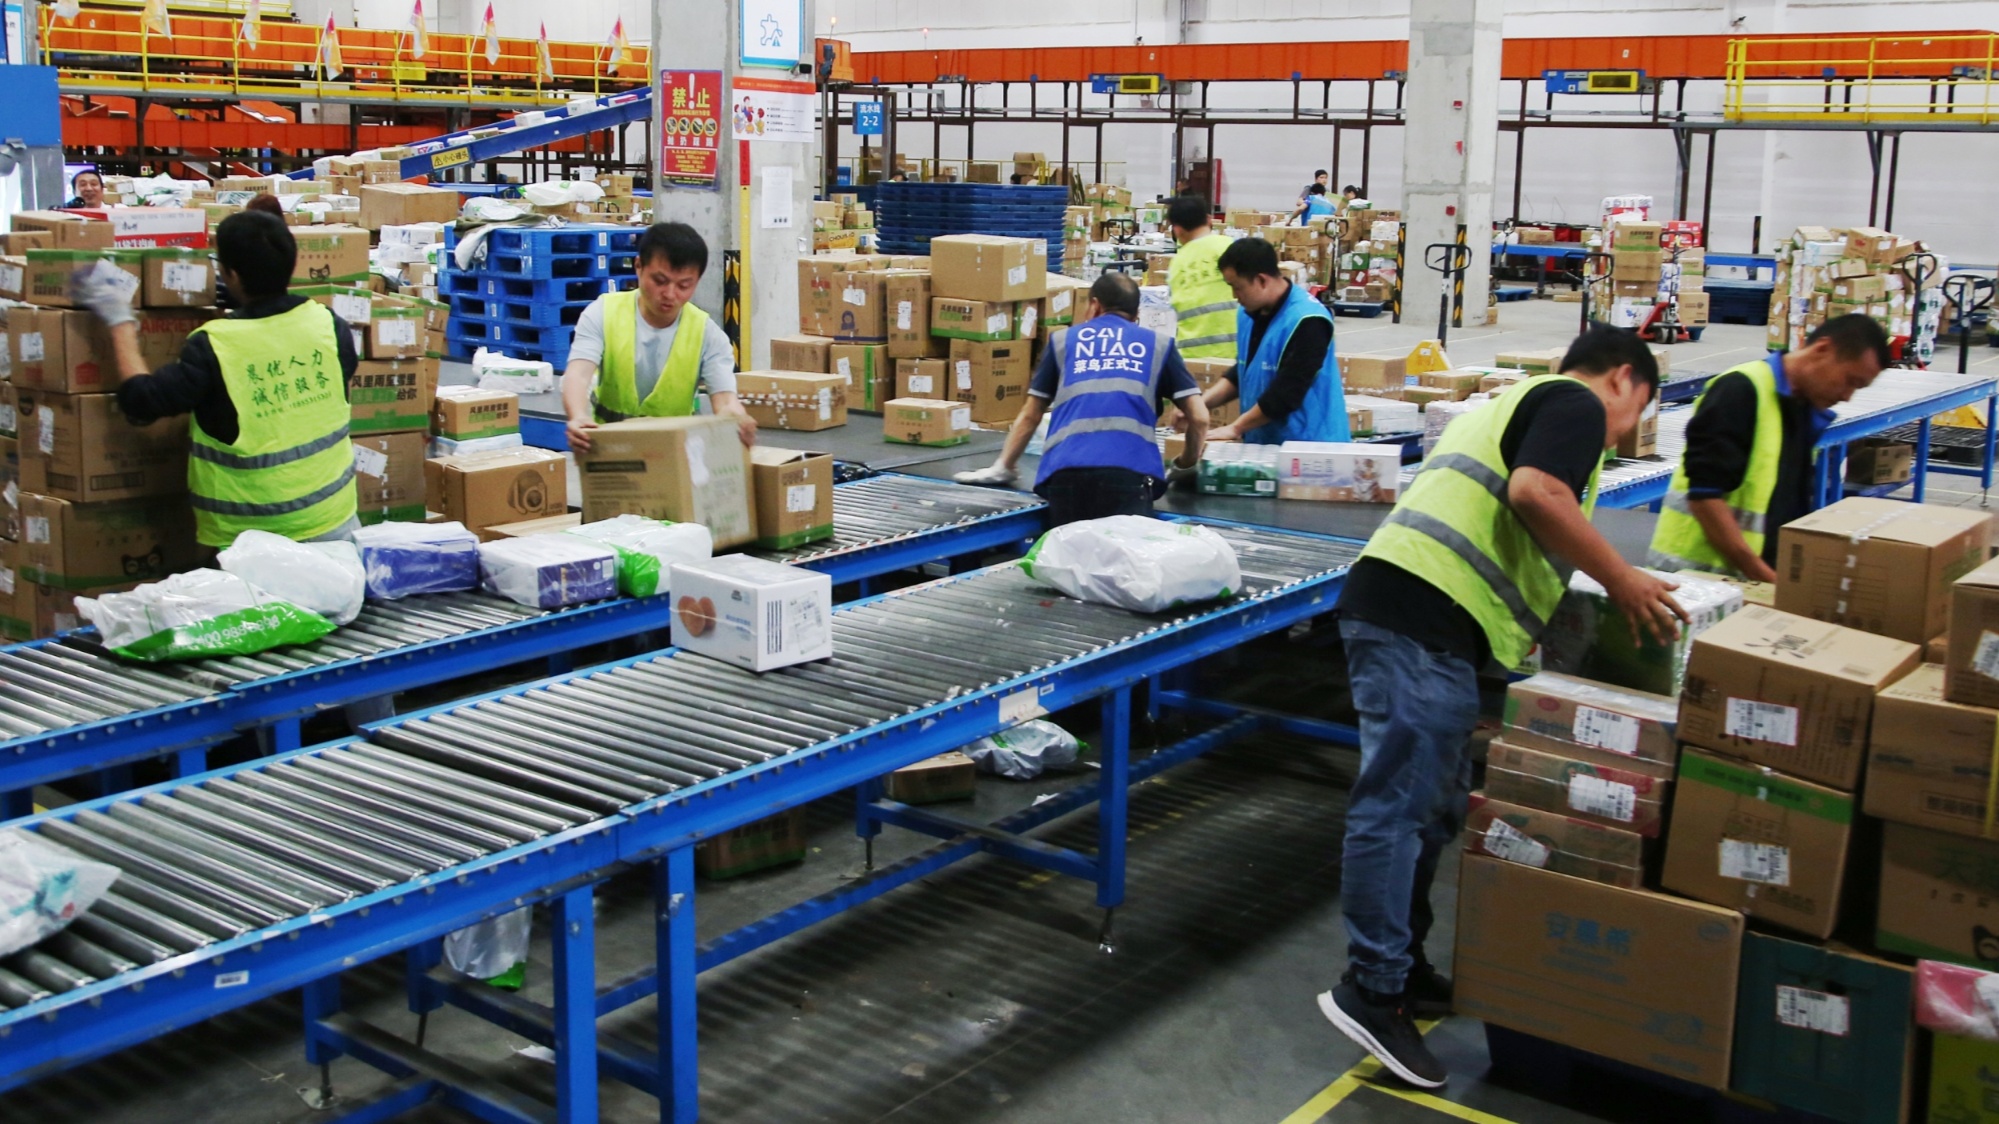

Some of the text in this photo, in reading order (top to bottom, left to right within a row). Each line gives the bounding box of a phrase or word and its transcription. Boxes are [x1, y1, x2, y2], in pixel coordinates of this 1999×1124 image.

[860, 104, 880, 113] 流水线
[862, 115, 879, 127] 2-2
[1077, 327, 1123, 341] CAI
[1075, 338, 1146, 358] NIAO
[1073, 357, 1143, 374] 菜鸟正式工
[251, 370, 330, 406] 诚信服务
[396, 388, 417, 400] 给你
